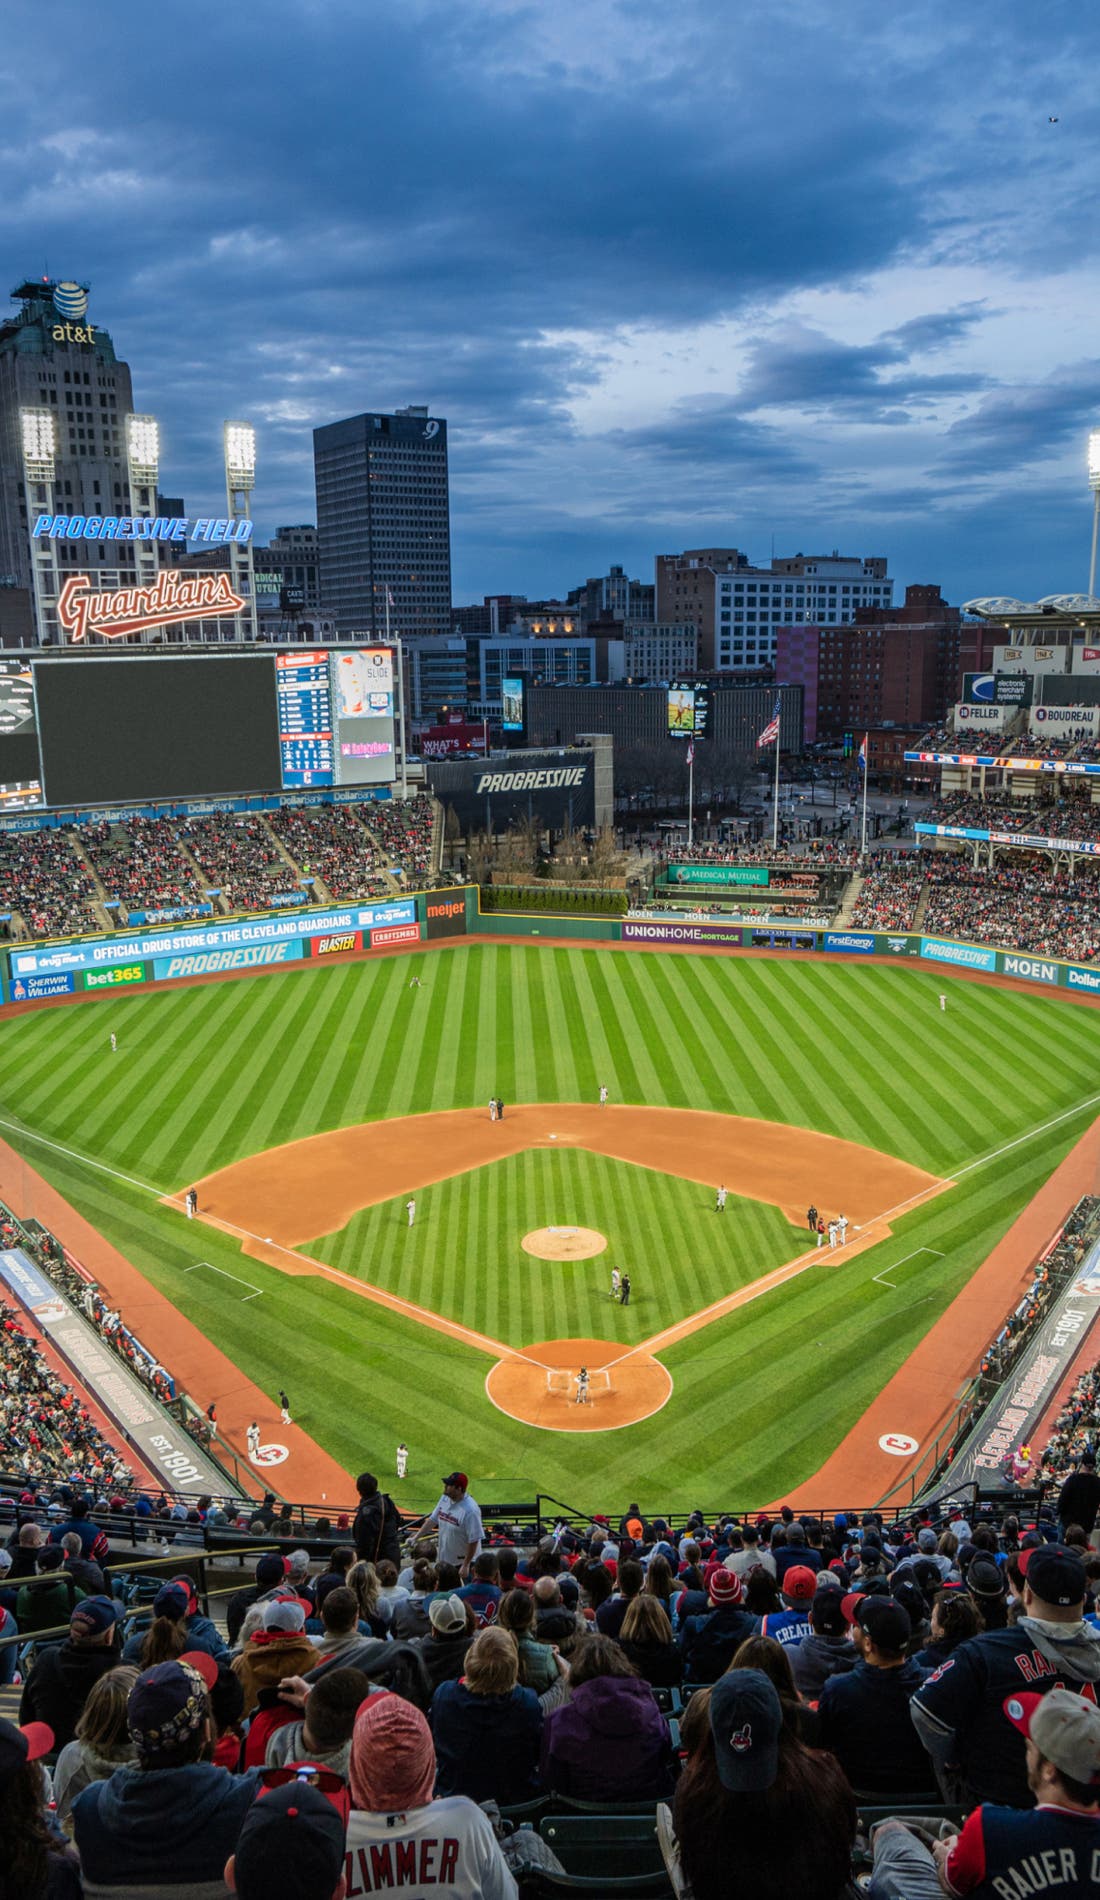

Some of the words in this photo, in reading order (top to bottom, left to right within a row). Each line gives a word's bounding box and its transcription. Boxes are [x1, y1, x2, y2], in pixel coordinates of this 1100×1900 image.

[52, 322, 96, 344] at&t
[422, 421, 440, 439] 9
[32, 515, 189, 541] PROGRESSIVE
[190, 519, 253, 542] FIELD
[57, 570, 246, 641] Guardians
[997, 680, 1026, 688] electronic
[997, 687, 1025, 695] merchant
[970, 708, 999, 719] FELLER
[1048, 710, 1094, 722] BOUDREAU
[423, 739, 459, 751] WHAT'S
[476, 768, 587, 794] PROGRESSIVE
[333, 790, 376, 802] DollarBank
[691, 870, 725, 880] MEDICAL
[728, 872, 760, 882] MUTUAL
[427, 900, 464, 918] meijer
[627, 910, 653, 919] MOEN
[683, 912, 710, 921] MOEN
[742, 914, 769, 924] MOEN
[801, 918, 829, 927] MOEN
[93, 944, 141, 960] OFFICIAL
[142, 941, 171, 954] DRUG
[172, 937, 205, 950] STORE
[206, 934, 219, 944] OF
[221, 930, 241, 941] THE
[241, 922, 297, 939] CLEVELAND
[298, 915, 351, 932] GUARDIANS
[375, 911, 392, 922] drug
[392, 909, 411, 918] mart
[375, 929, 416, 942] CRAFTSMAN
[701, 933, 739, 942] MORTGAGE
[828, 936, 874, 949] FirstEnergy
[318, 935, 356, 954] BLASTER
[39, 957, 62, 968] drug
[62, 953, 85, 964] mart
[167, 943, 289, 976] PROGRESSIVE
[924, 942, 991, 966] PROGRESSIVE
[86, 967, 142, 986] bet365
[1004, 957, 1054, 981] MOEN
[28, 976, 67, 989] SHERWIN
[975, 1408, 1029, 1468] CLEVELAND
[1061, 1309, 1087, 1336] 1901
[150, 1434, 173, 1454] EST.
[159, 1450, 204, 1485] 1901
[1014, 1649, 1057, 1682] RA
[992, 1848, 1079, 1900] BAUER
